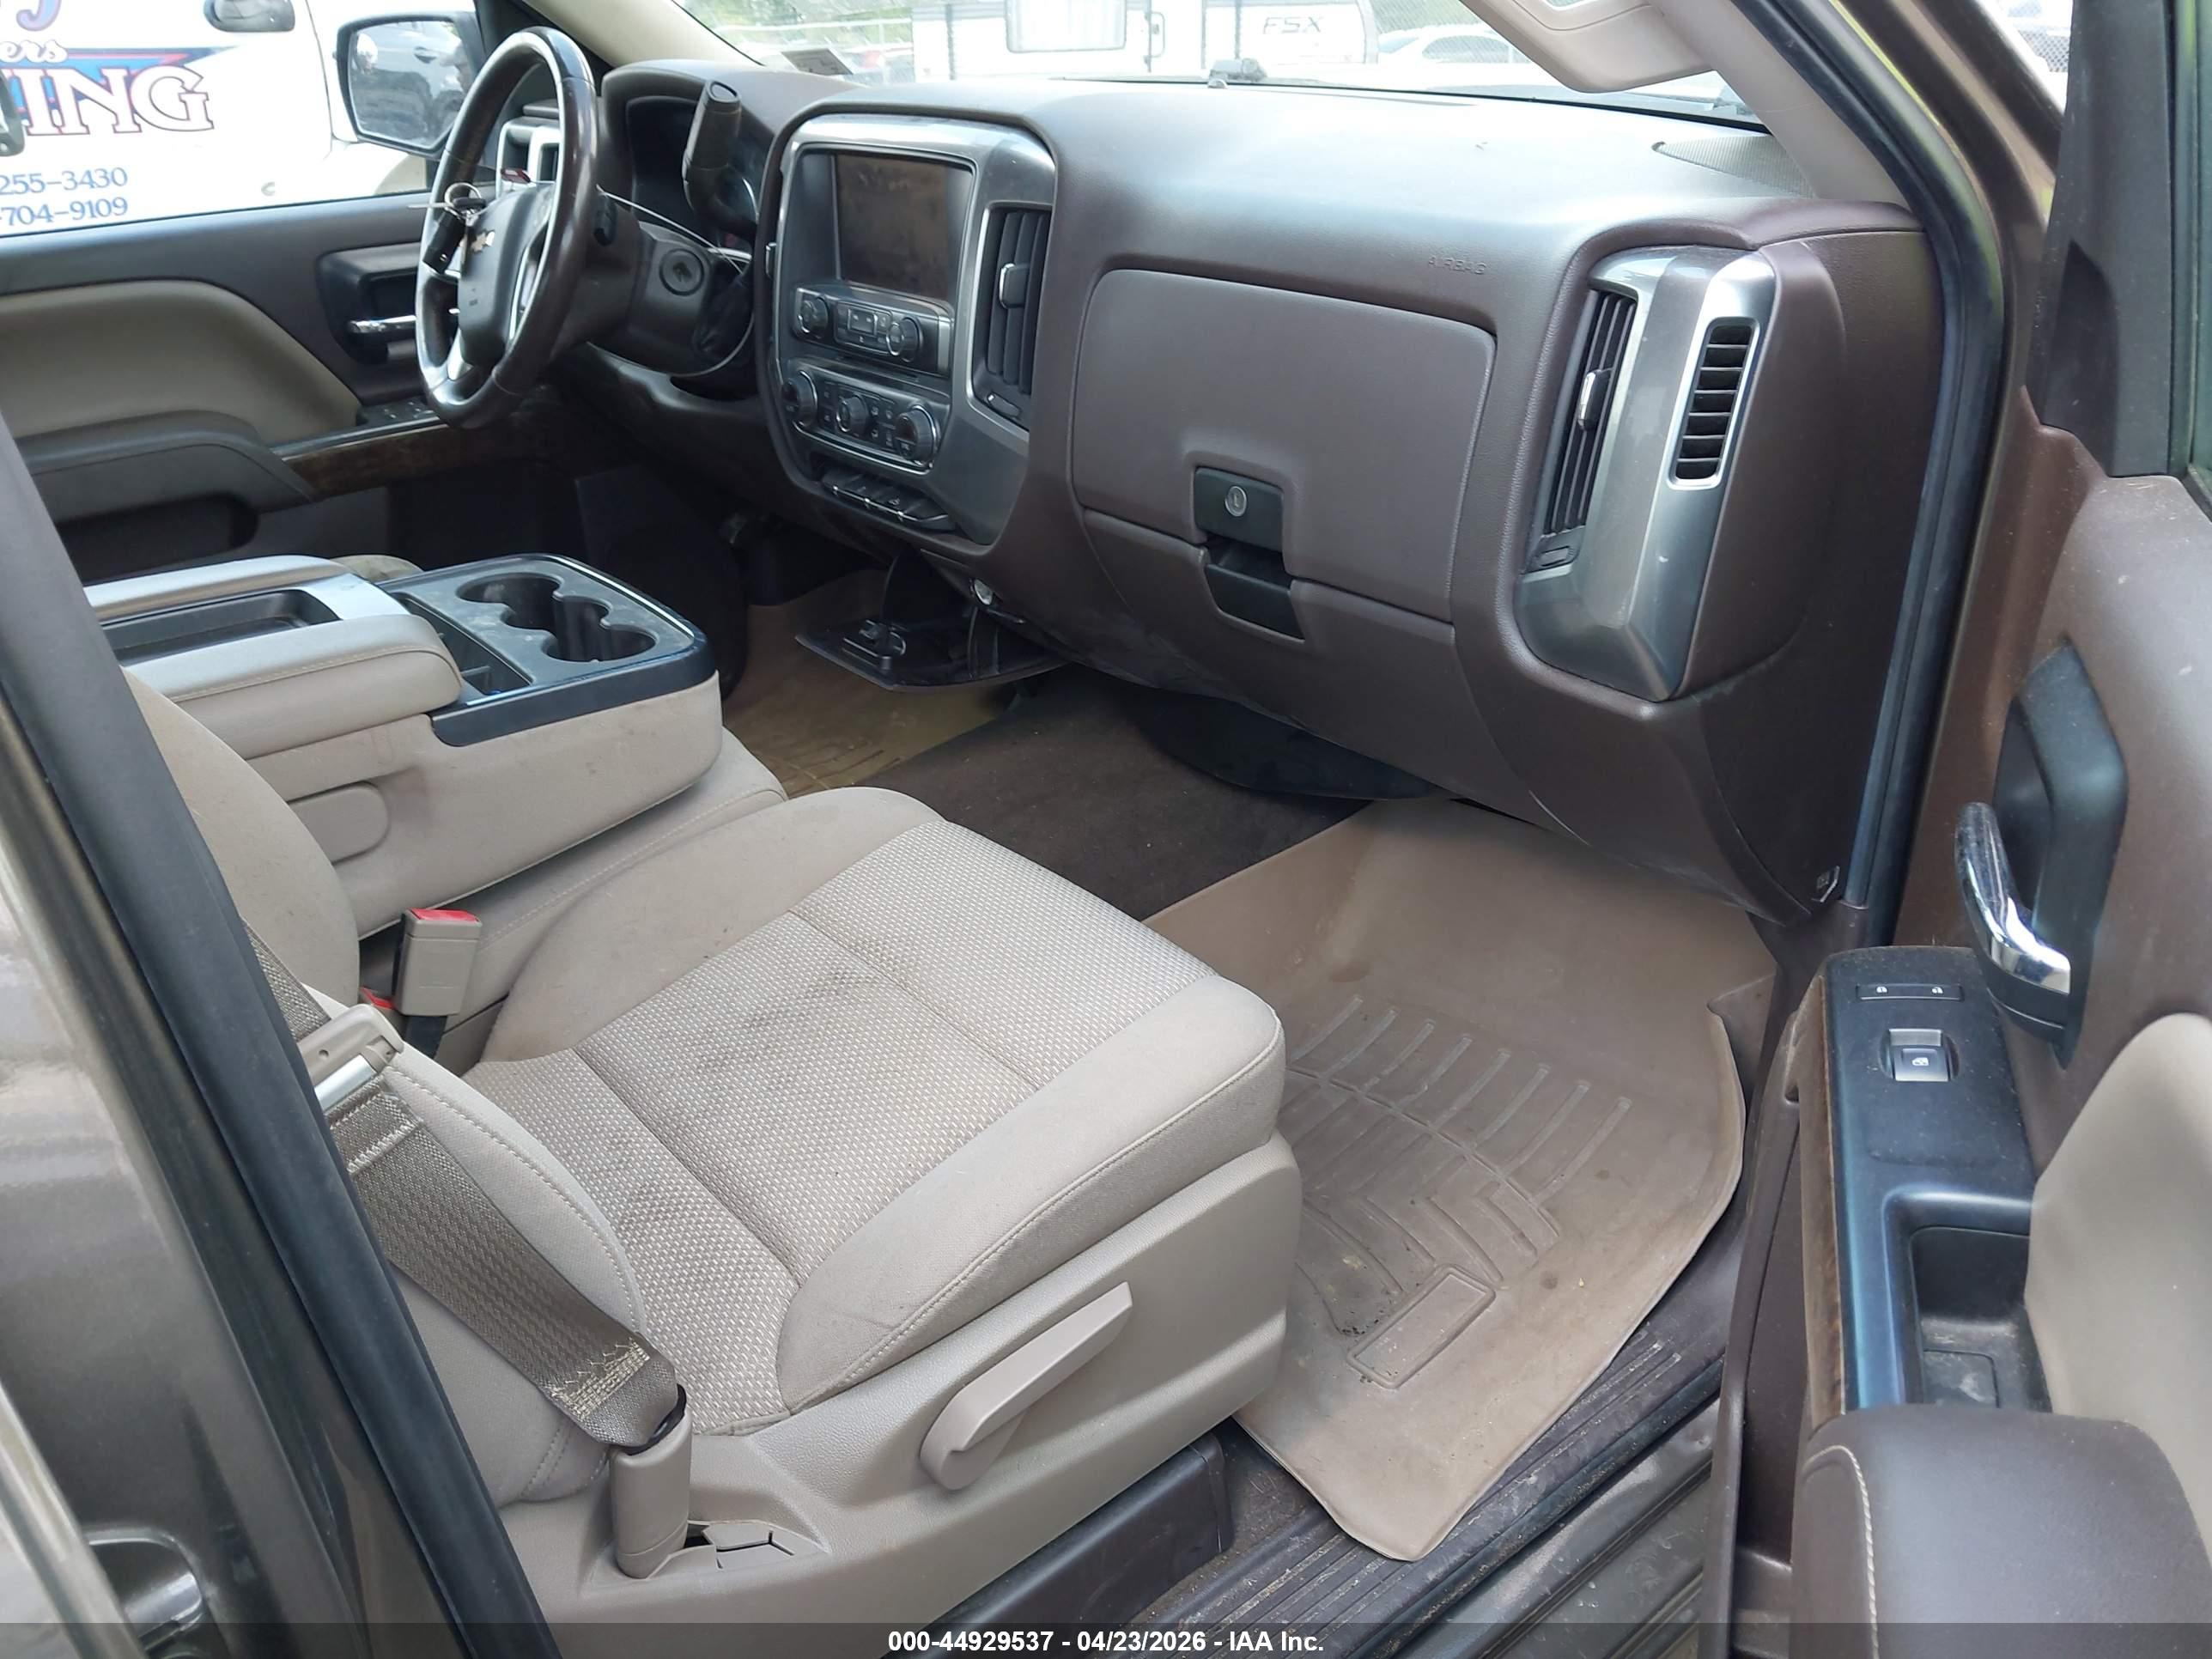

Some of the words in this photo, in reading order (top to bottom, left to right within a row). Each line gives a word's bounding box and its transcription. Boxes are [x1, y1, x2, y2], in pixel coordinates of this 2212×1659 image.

[1263, 16, 1323, 33] FSX
[0, 65, 215, 136] ING
[0, 197, 128, 227] 704-9109
